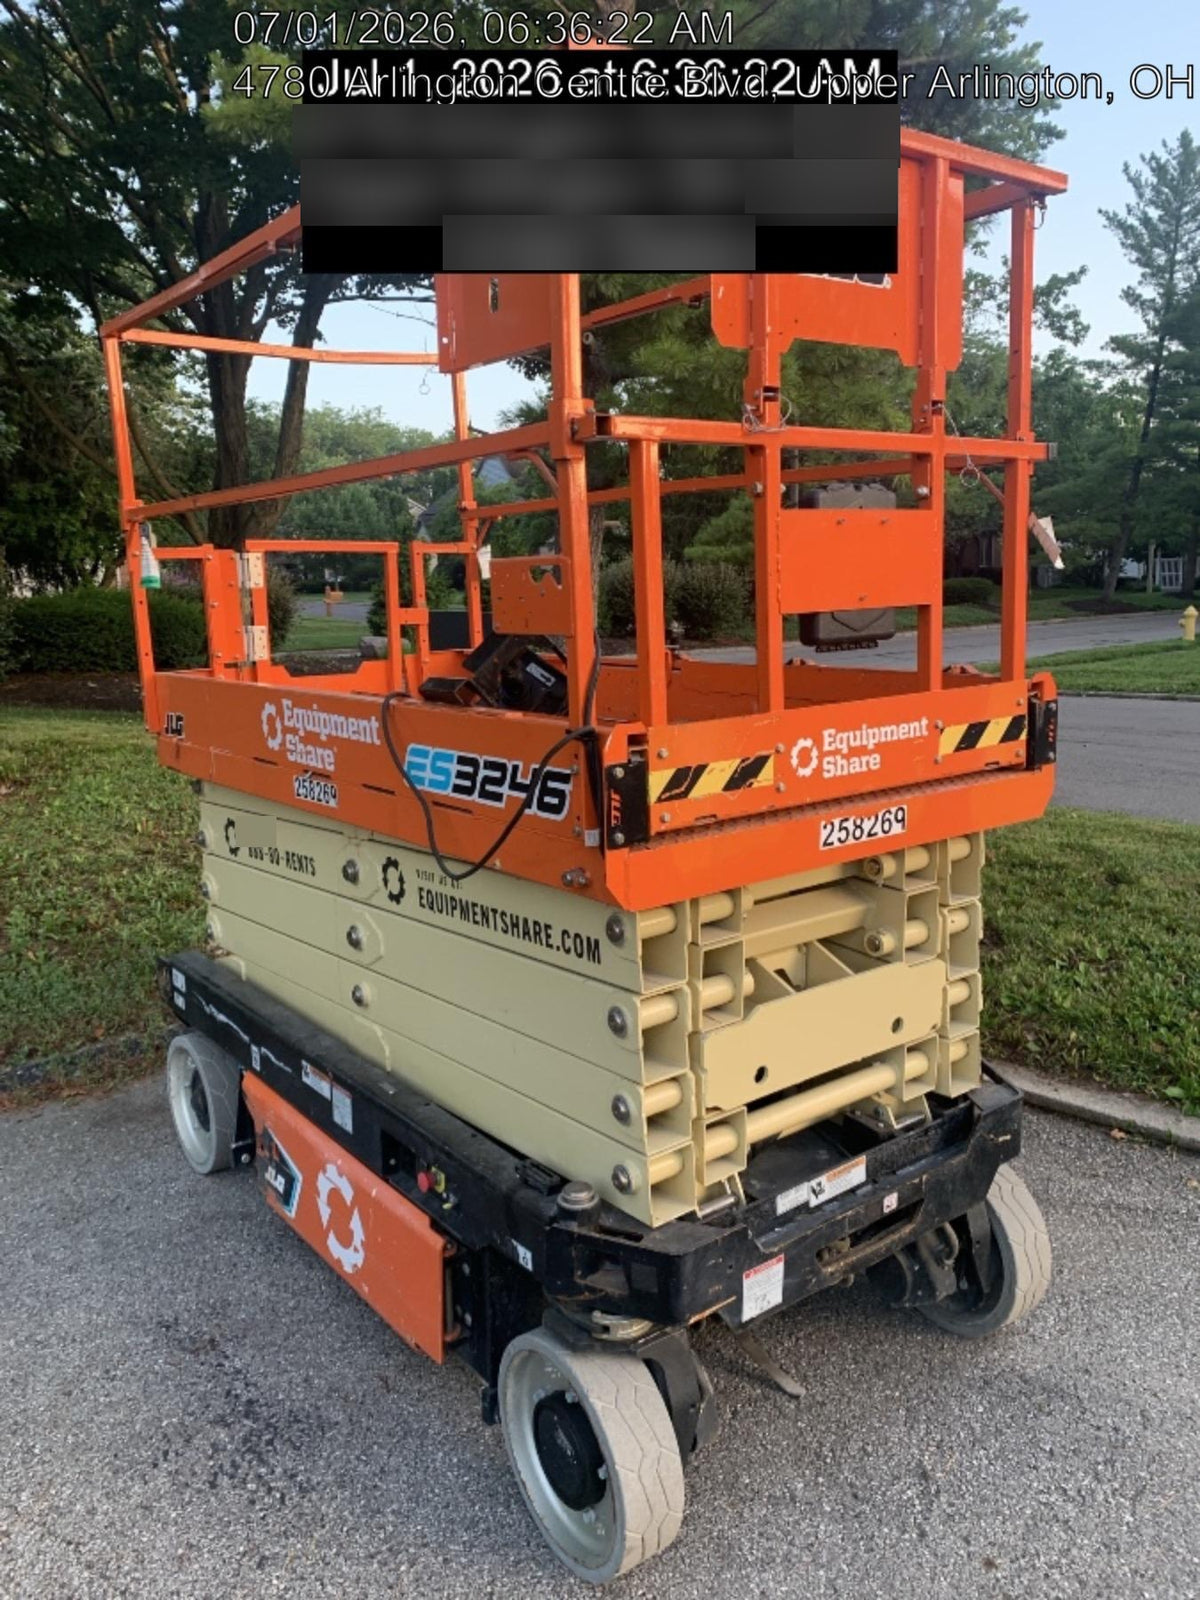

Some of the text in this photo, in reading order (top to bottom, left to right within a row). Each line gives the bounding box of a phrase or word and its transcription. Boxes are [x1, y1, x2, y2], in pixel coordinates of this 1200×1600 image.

[165, 713, 185, 738] JLG
[282, 698, 381, 745] Equipment
[822, 716, 929, 752] Equipment
[285, 734, 336, 771] Share
[822, 750, 881, 779] Share
[295, 776, 337, 805] 258269
[405, 744, 573, 821] ES3246
[822, 807, 907, 848] 258269
[417, 887, 602, 964] EQUIPMENTSHARE.COM
